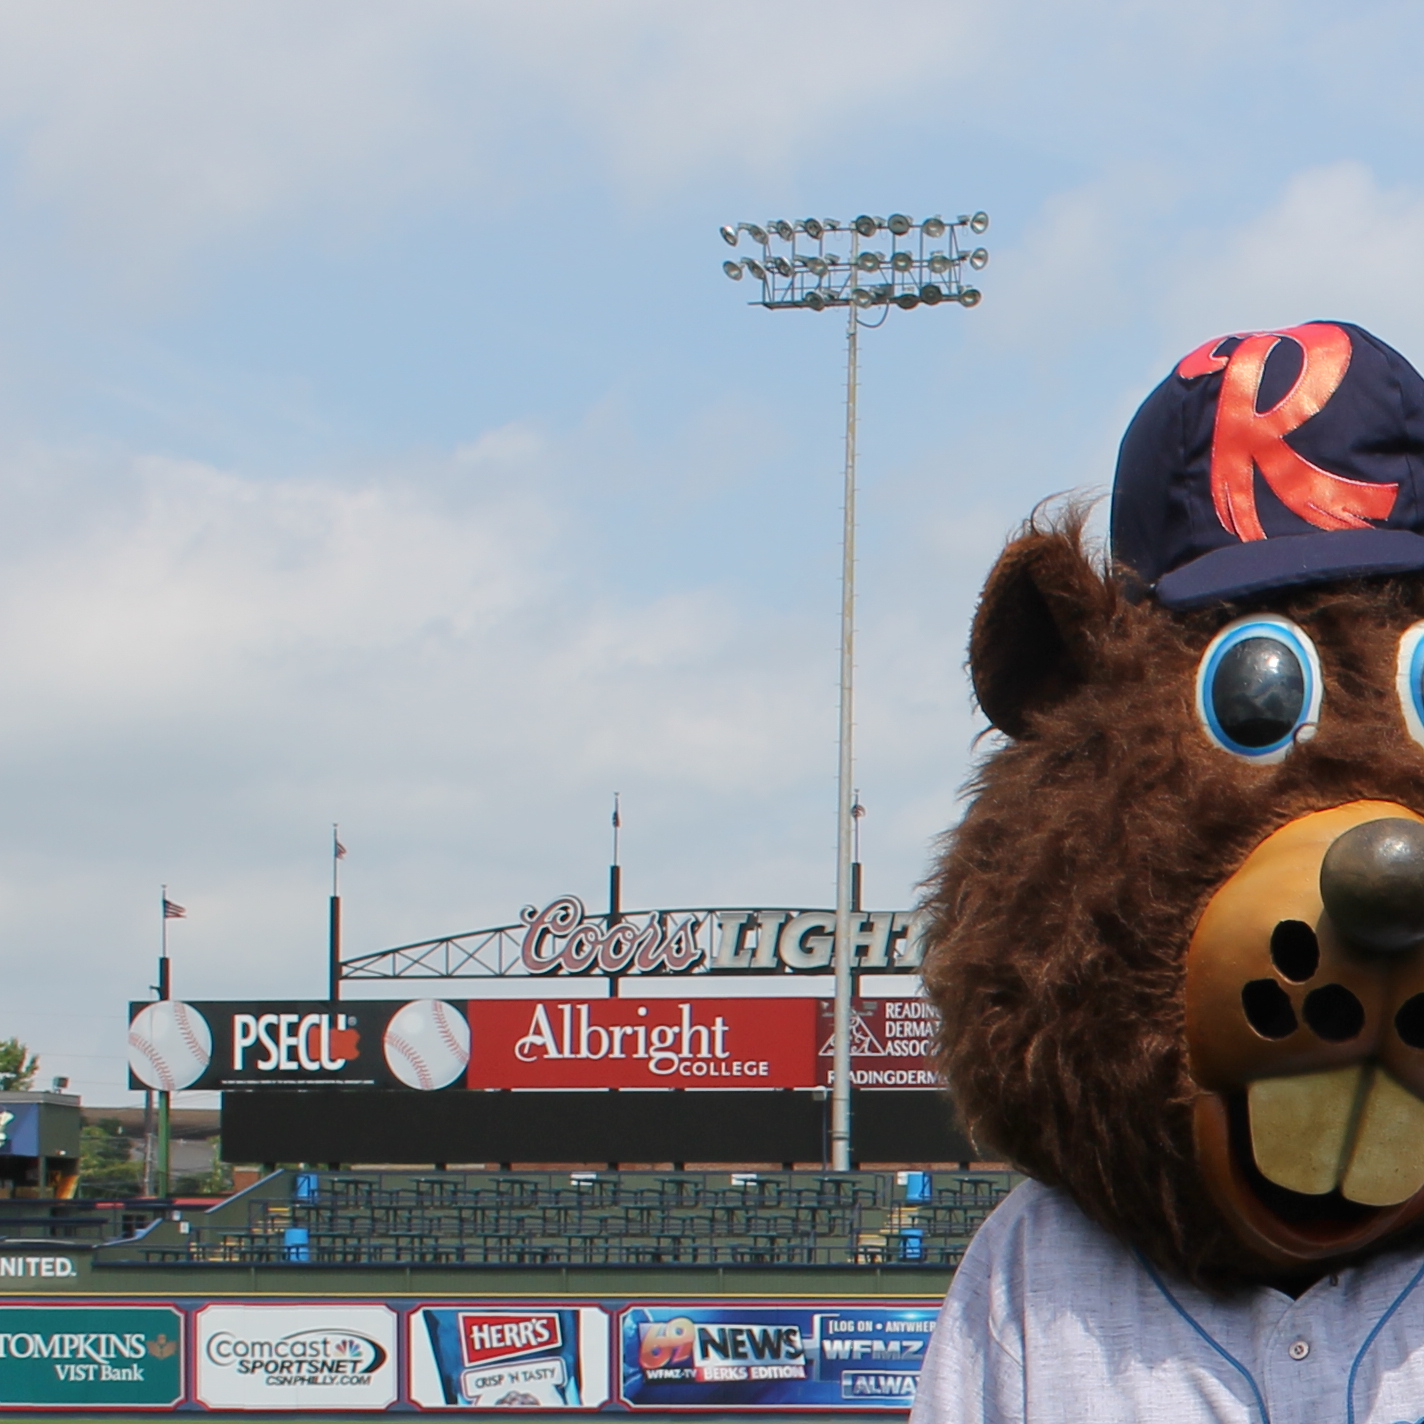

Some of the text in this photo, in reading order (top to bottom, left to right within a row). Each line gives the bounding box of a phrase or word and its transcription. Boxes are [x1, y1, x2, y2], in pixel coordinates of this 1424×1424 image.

[1176, 323, 1399, 543] R
[520, 894, 706, 975] Coors
[234, 1013, 347, 1071] PSECU
[514, 1003, 730, 1075] Albright
[679, 1061, 769, 1077] COLLEGE
[470, 1318, 551, 1350] HERR'S
[857, 1320, 873, 1332] ON
[639, 1317, 804, 1369] 69 NEWS
[55, 1363, 144, 1381] VIST Bank
[238, 1359, 363, 1375] SPORTSNET
[645, 1365, 806, 1380] WFMZ-TV BERKS EDITION
[265, 1376, 372, 1386] CSNPHILLY.COM
[475, 1373, 504, 1389] CRISP
[521, 1367, 556, 1382] TASTY
[853, 1375, 920, 1396] ALWA
